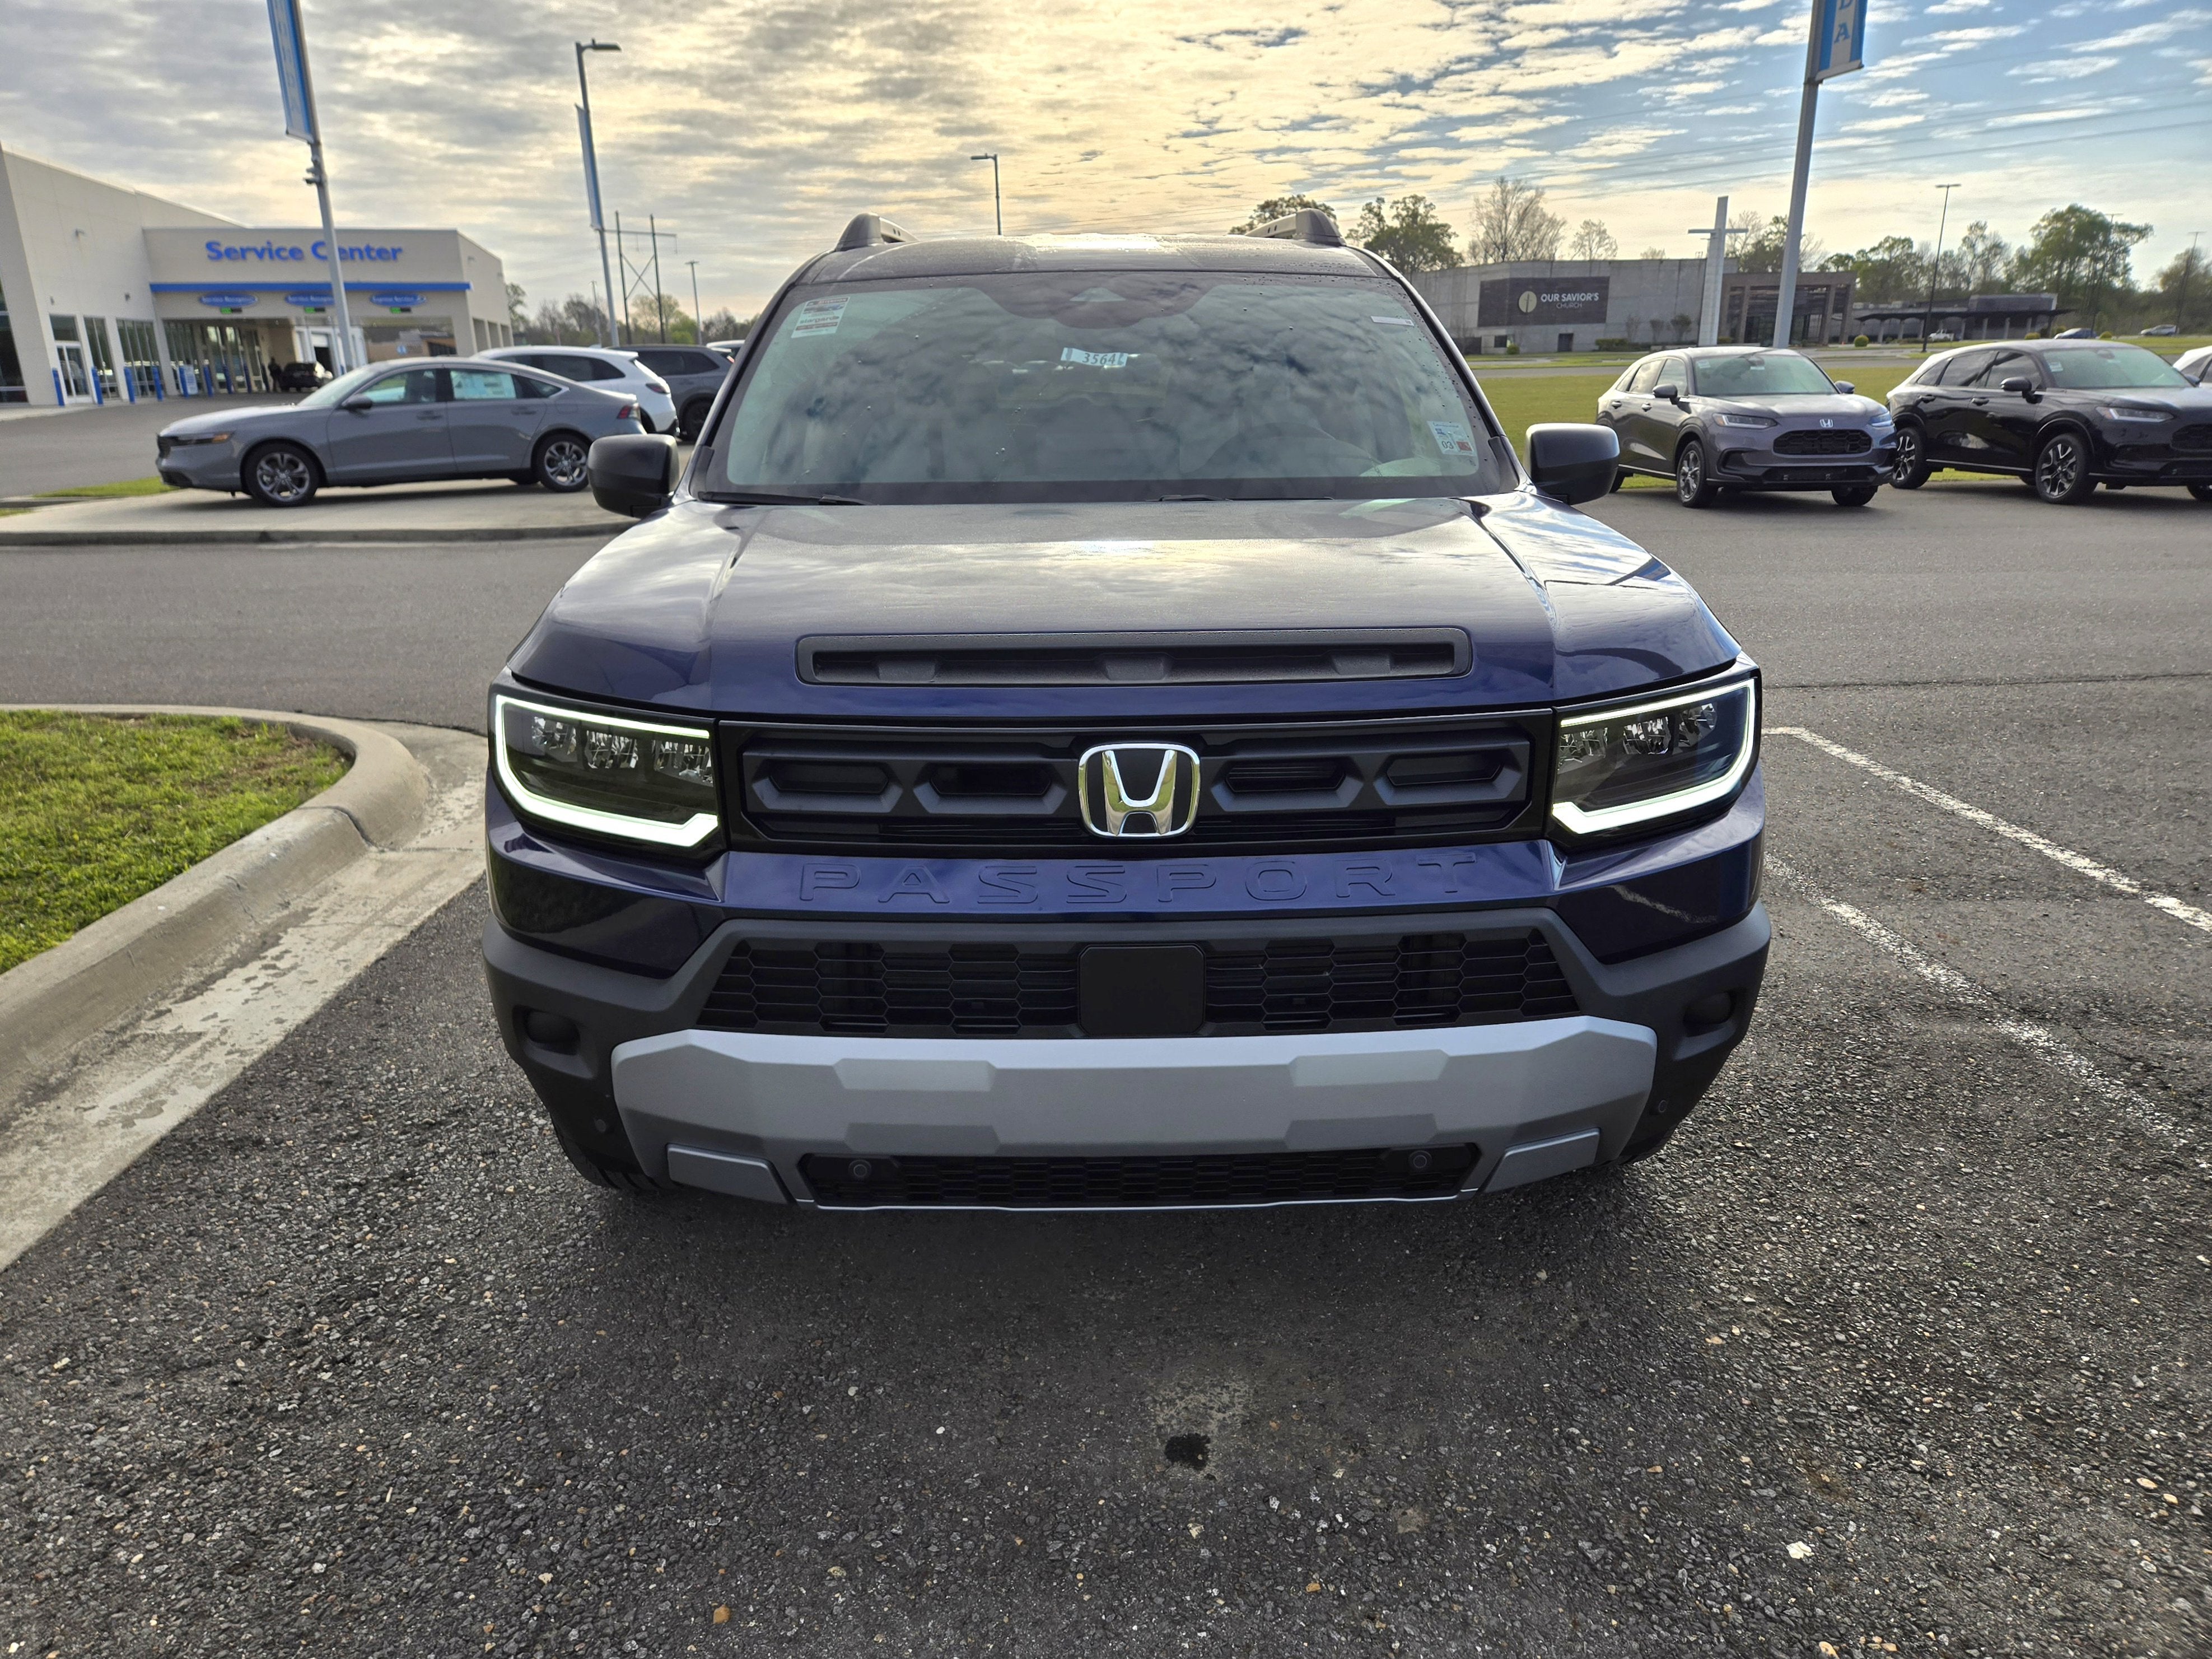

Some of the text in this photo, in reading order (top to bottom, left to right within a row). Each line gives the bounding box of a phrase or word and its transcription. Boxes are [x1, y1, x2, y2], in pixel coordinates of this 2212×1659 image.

[206, 240, 403, 262] Service Center
[1541, 292, 1599, 302] OUR SAVIOR'S
[1441, 441, 1454, 449] 03
[799, 852, 1476, 904] PASSPORT
